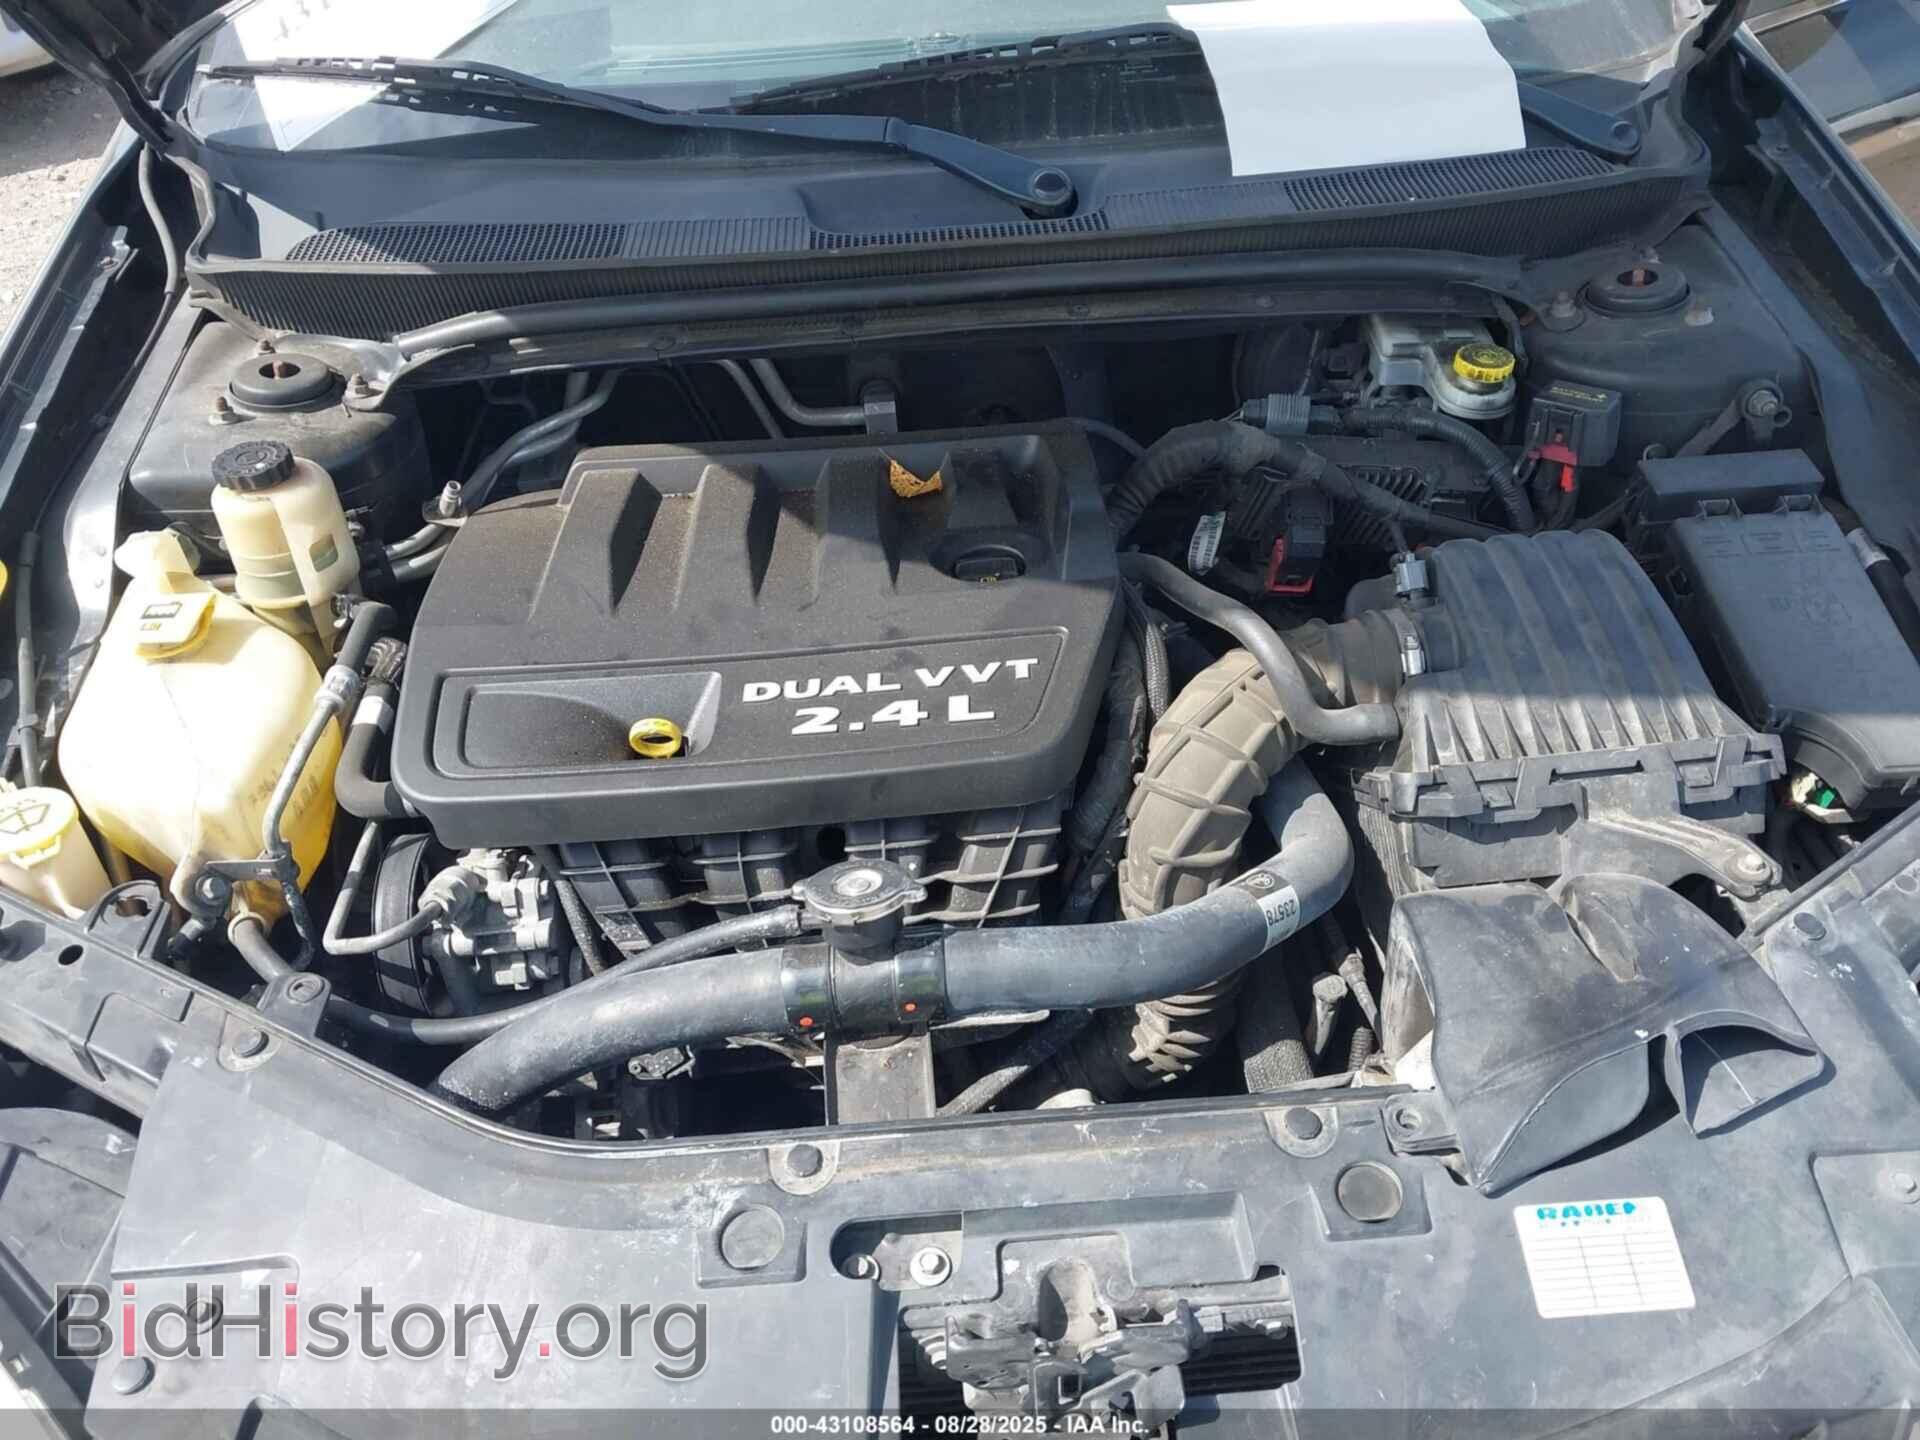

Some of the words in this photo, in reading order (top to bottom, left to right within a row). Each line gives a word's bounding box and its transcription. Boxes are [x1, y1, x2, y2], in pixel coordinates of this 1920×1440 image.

[742, 672, 902, 703] DUAL
[914, 657, 1039, 688] VVT
[791, 699, 929, 736] 2.4
[948, 694, 996, 723] L
[1265, 899, 1297, 926] 23578
